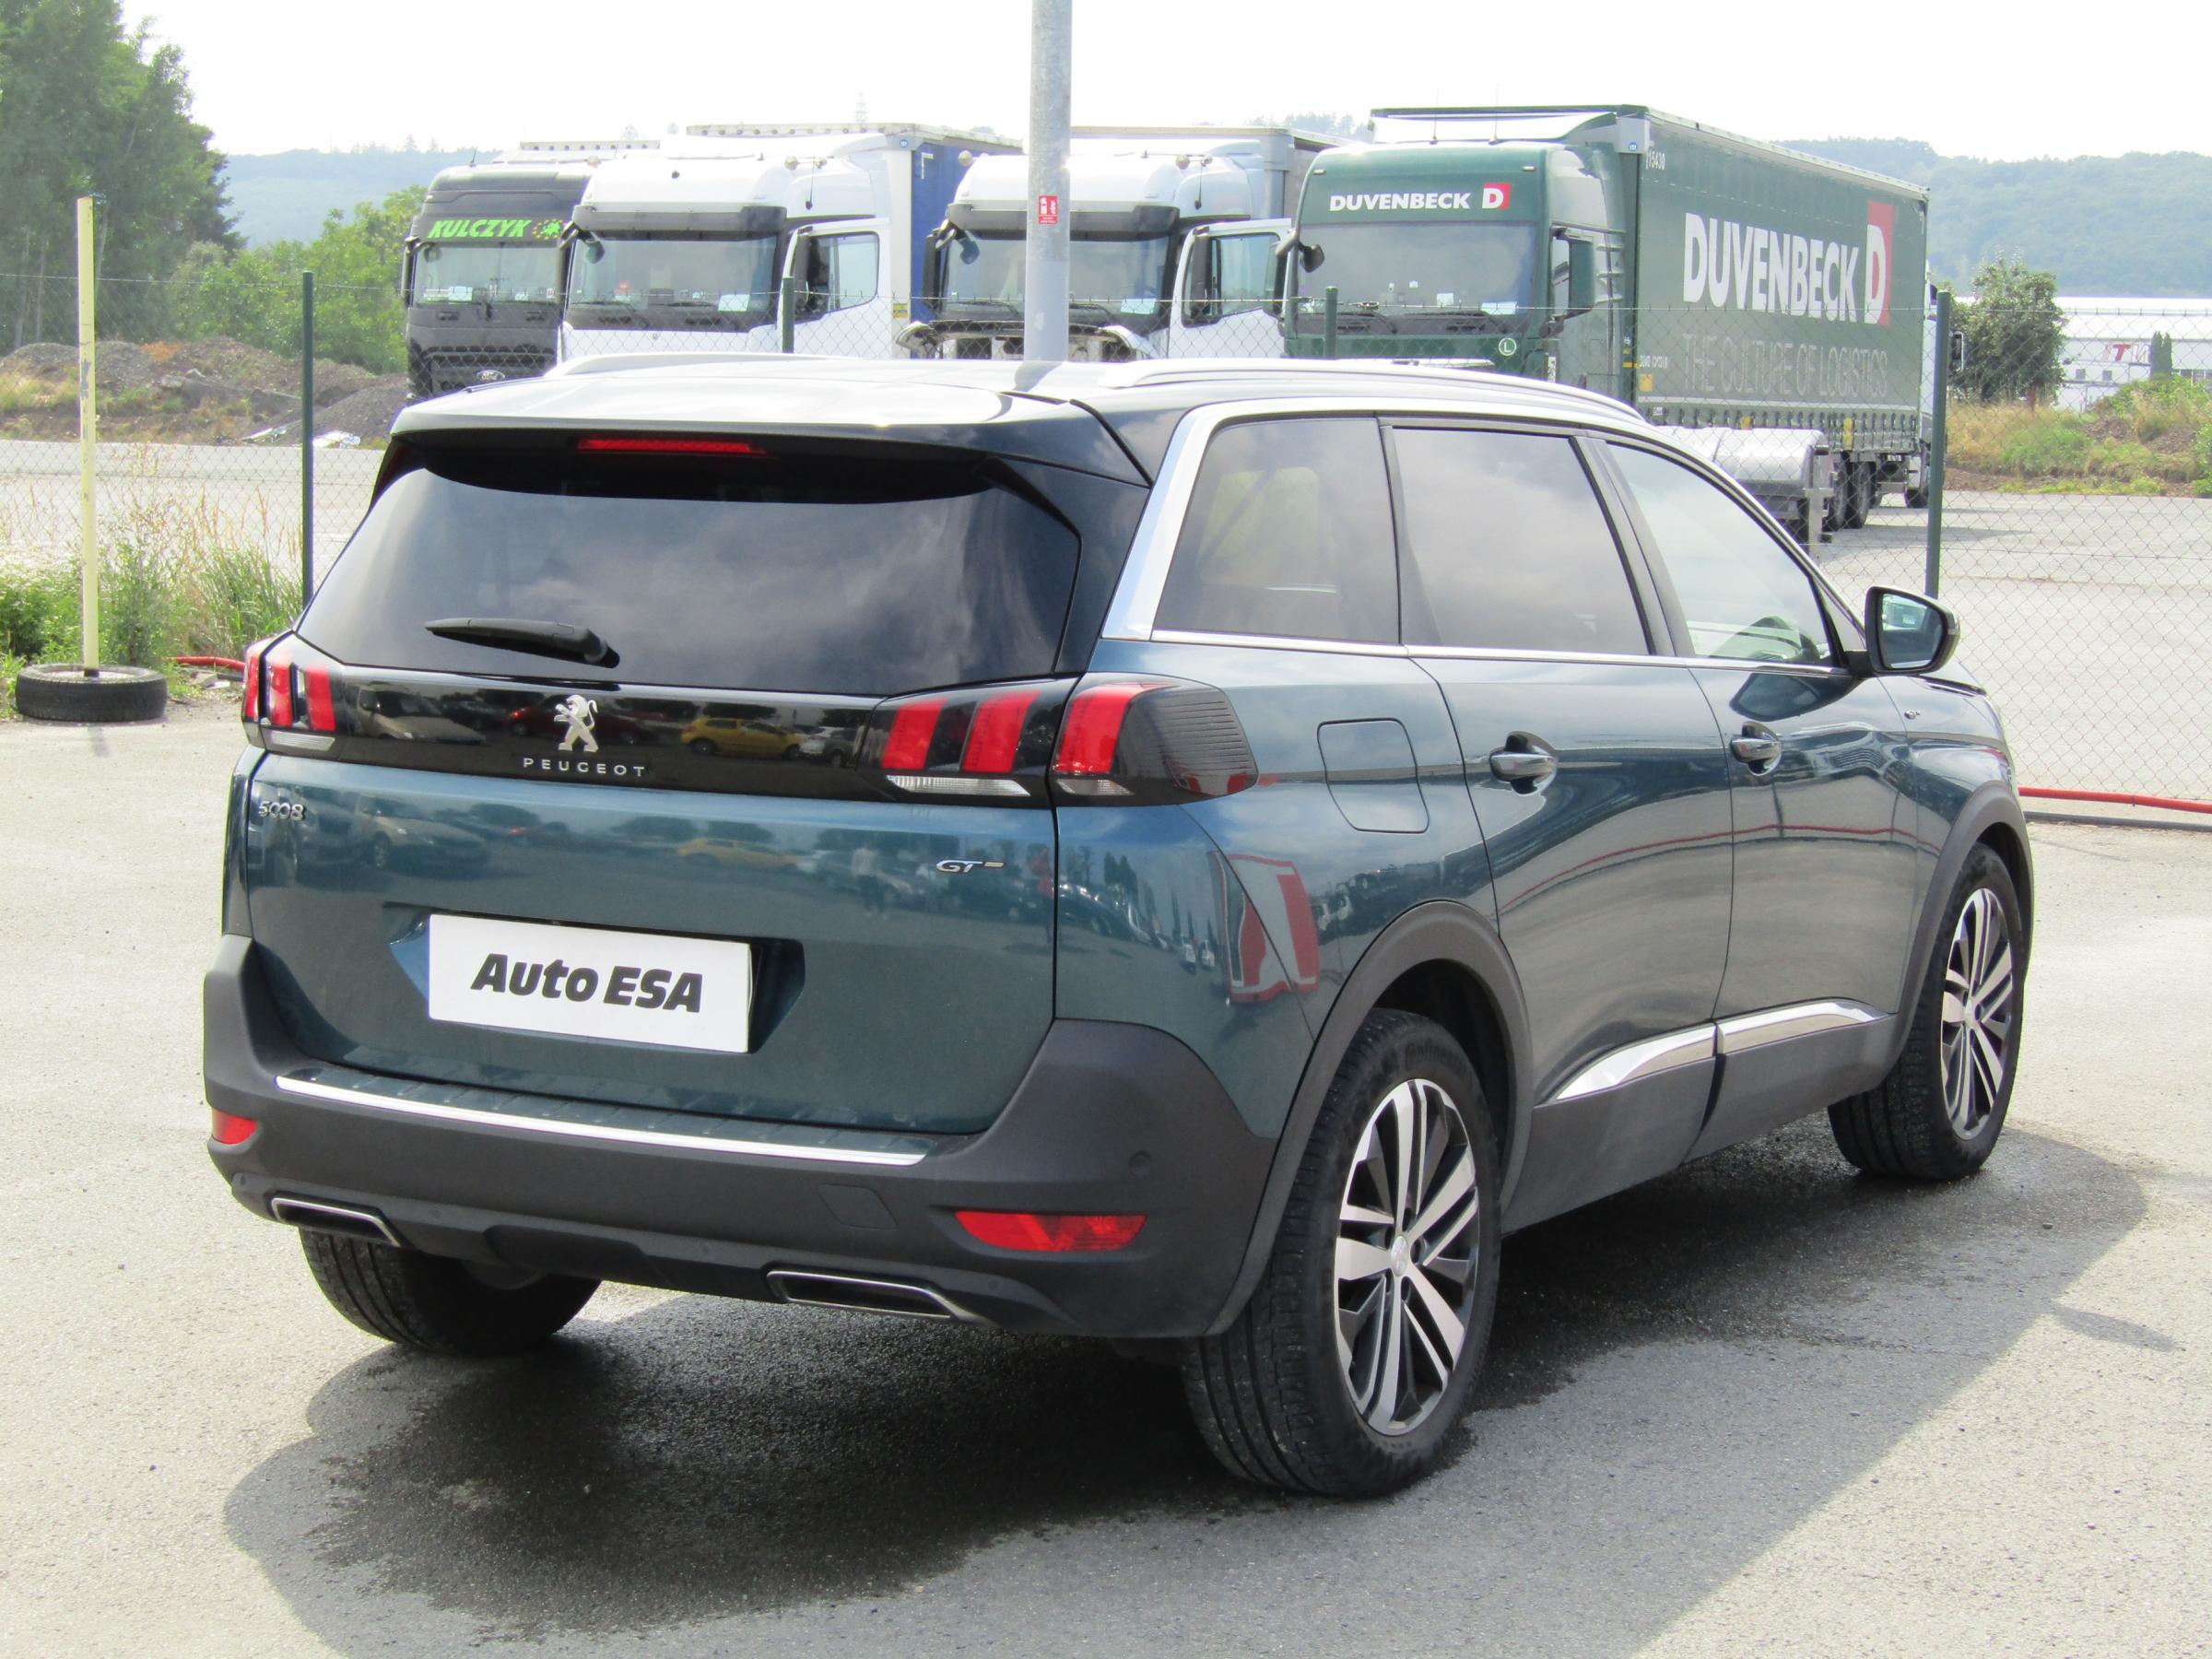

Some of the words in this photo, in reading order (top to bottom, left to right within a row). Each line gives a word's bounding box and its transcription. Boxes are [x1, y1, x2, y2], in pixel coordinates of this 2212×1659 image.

[1330, 192, 1471, 211] DUVENBECK
[1481, 187, 1504, 209] D
[427, 219, 533, 239] KULCZYK
[1683, 212, 1859, 323] DUVENBECK
[1864, 224, 1887, 324] D
[1721, 335, 1794, 395] CULTURE
[1819, 346, 1888, 398] LOGISTICS
[524, 758, 644, 777] PEUGEOT
[258, 800, 305, 821] 5008
[935, 859, 984, 873] GT
[470, 953, 599, 1002] Auto
[603, 965, 703, 1013] ESA
